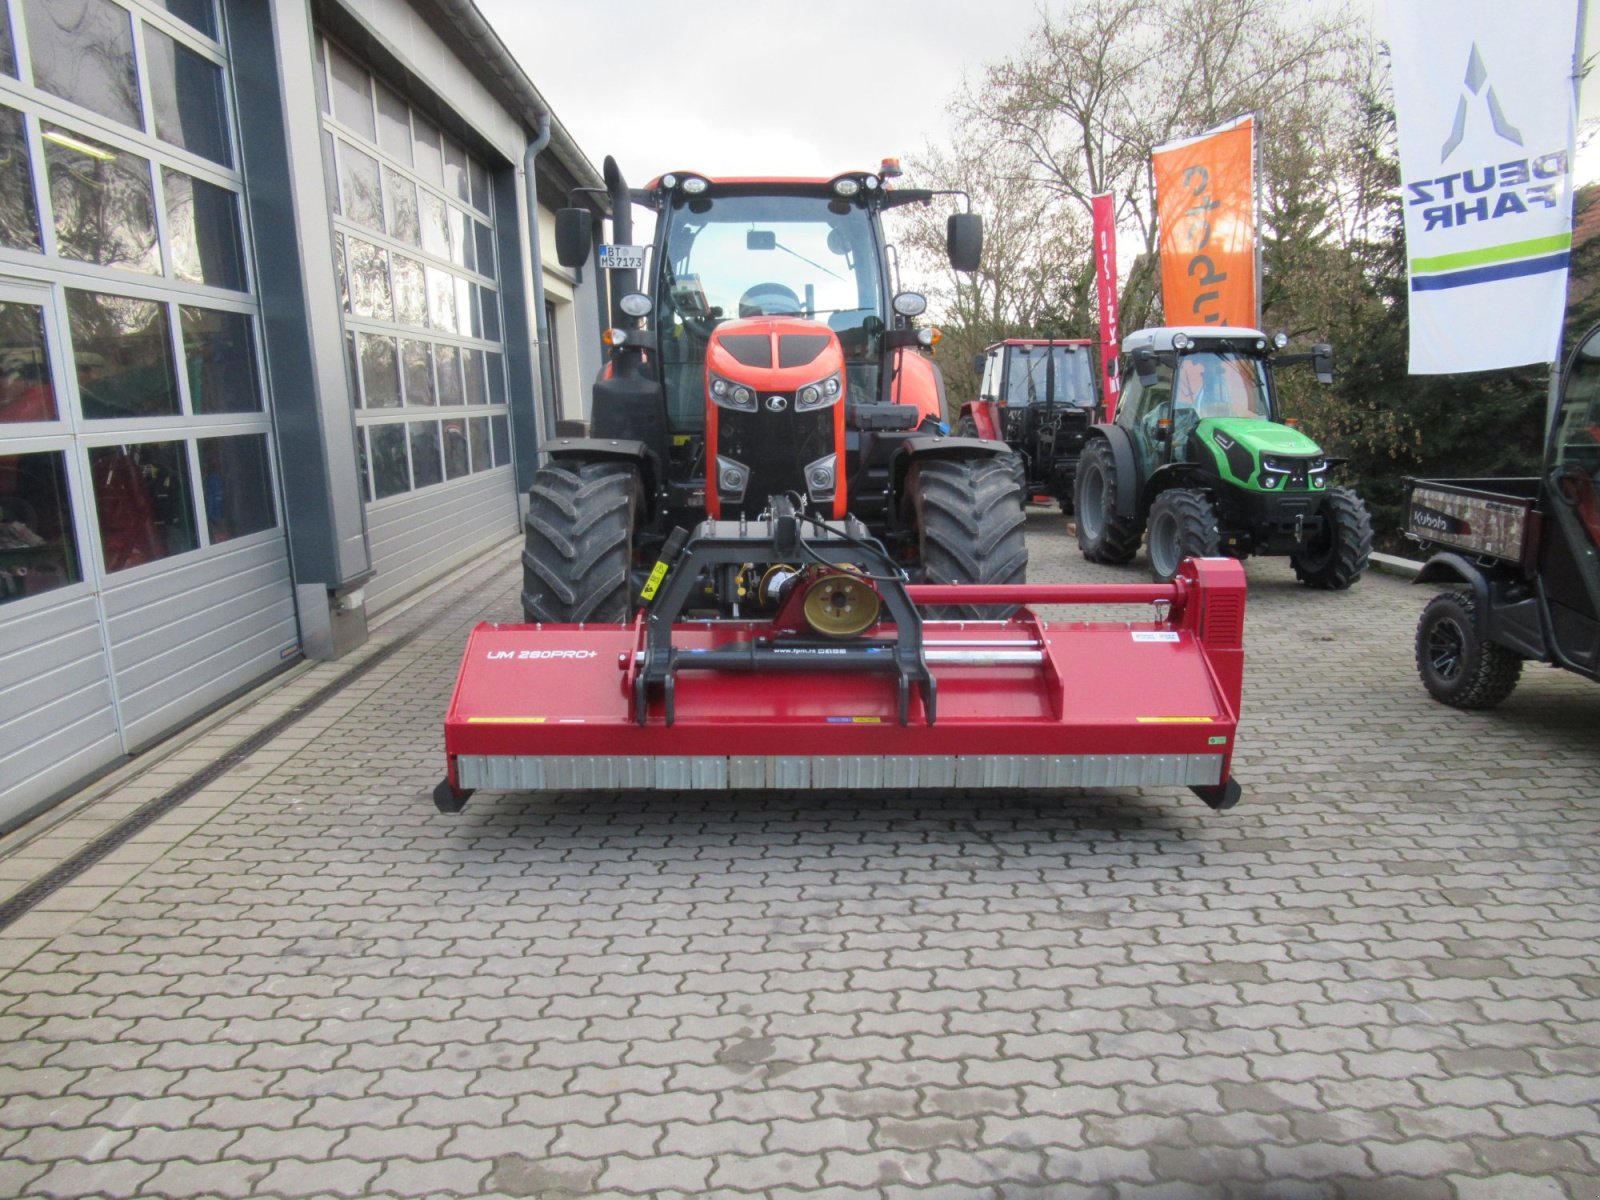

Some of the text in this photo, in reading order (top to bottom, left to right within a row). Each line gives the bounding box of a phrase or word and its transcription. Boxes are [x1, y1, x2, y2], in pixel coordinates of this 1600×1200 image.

[607, 247, 621, 257] BT
[1414, 511, 1447, 530] Kubota
[486, 650, 598, 660] UM 280PRO+
